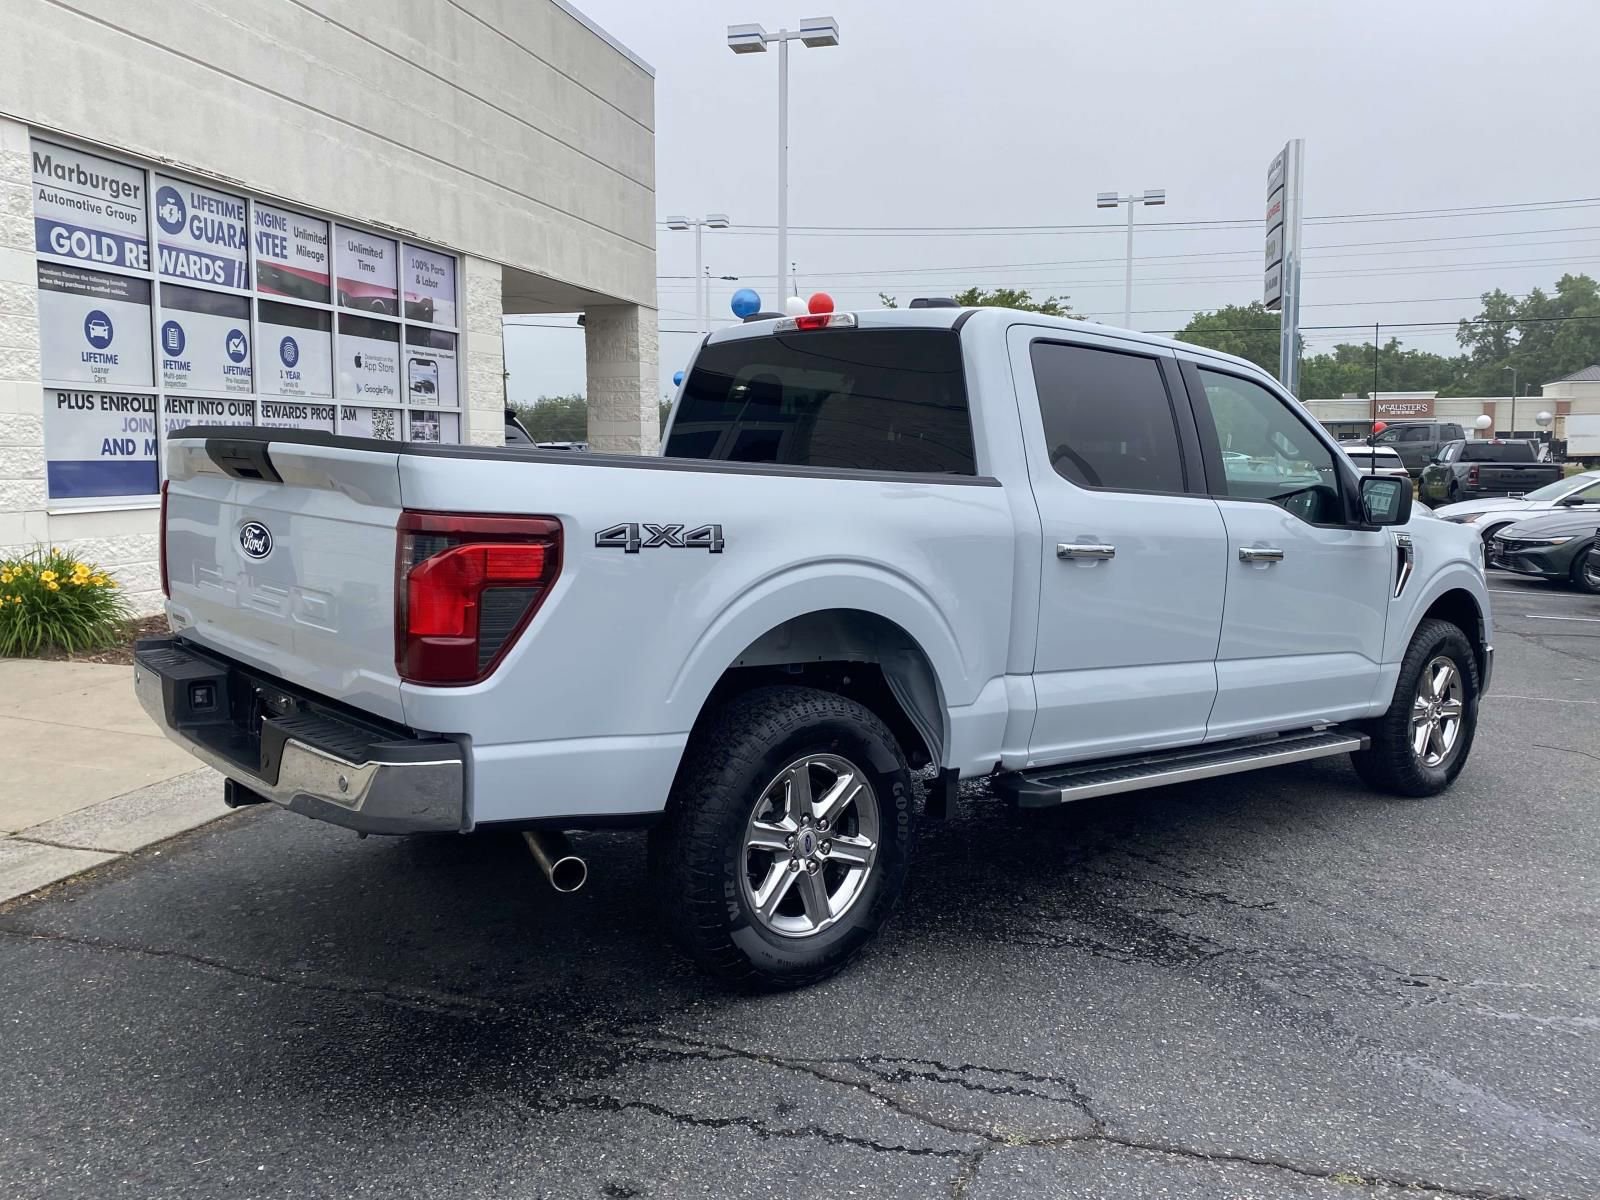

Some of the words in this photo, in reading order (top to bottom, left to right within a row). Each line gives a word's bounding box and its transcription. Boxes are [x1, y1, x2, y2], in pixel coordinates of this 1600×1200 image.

[33, 152, 140, 200] Marburger
[39, 189, 102, 215] Automotive
[105, 205, 138, 227] Group
[190, 193, 244, 221] LIFETIME
[294, 225, 327, 246] Unlimited
[50, 227, 118, 263] GOLD
[296, 245, 325, 263] Mileage
[348, 240, 383, 260] Unlimited
[358, 259, 375, 274] Time
[411, 258, 429, 273] 100%
[430, 264, 446, 277] Parts
[421, 277, 438, 289] Labor
[81, 351, 119, 365] LIFETIME
[163, 360, 191, 372] IFETIME
[223, 365, 252, 378] LIFETIME
[280, 370, 284, 379] 1
[285, 370, 301, 380] YEAR
[364, 361, 377, 373] App
[378, 362, 395, 374] Store
[364, 383, 383, 396] Google
[57, 393, 95, 410] PLUS
[197, 399, 225, 417] INTO
[228, 402, 252, 418] OUR
[101, 438, 136, 456] AND
[243, 526, 266, 553] Ford
